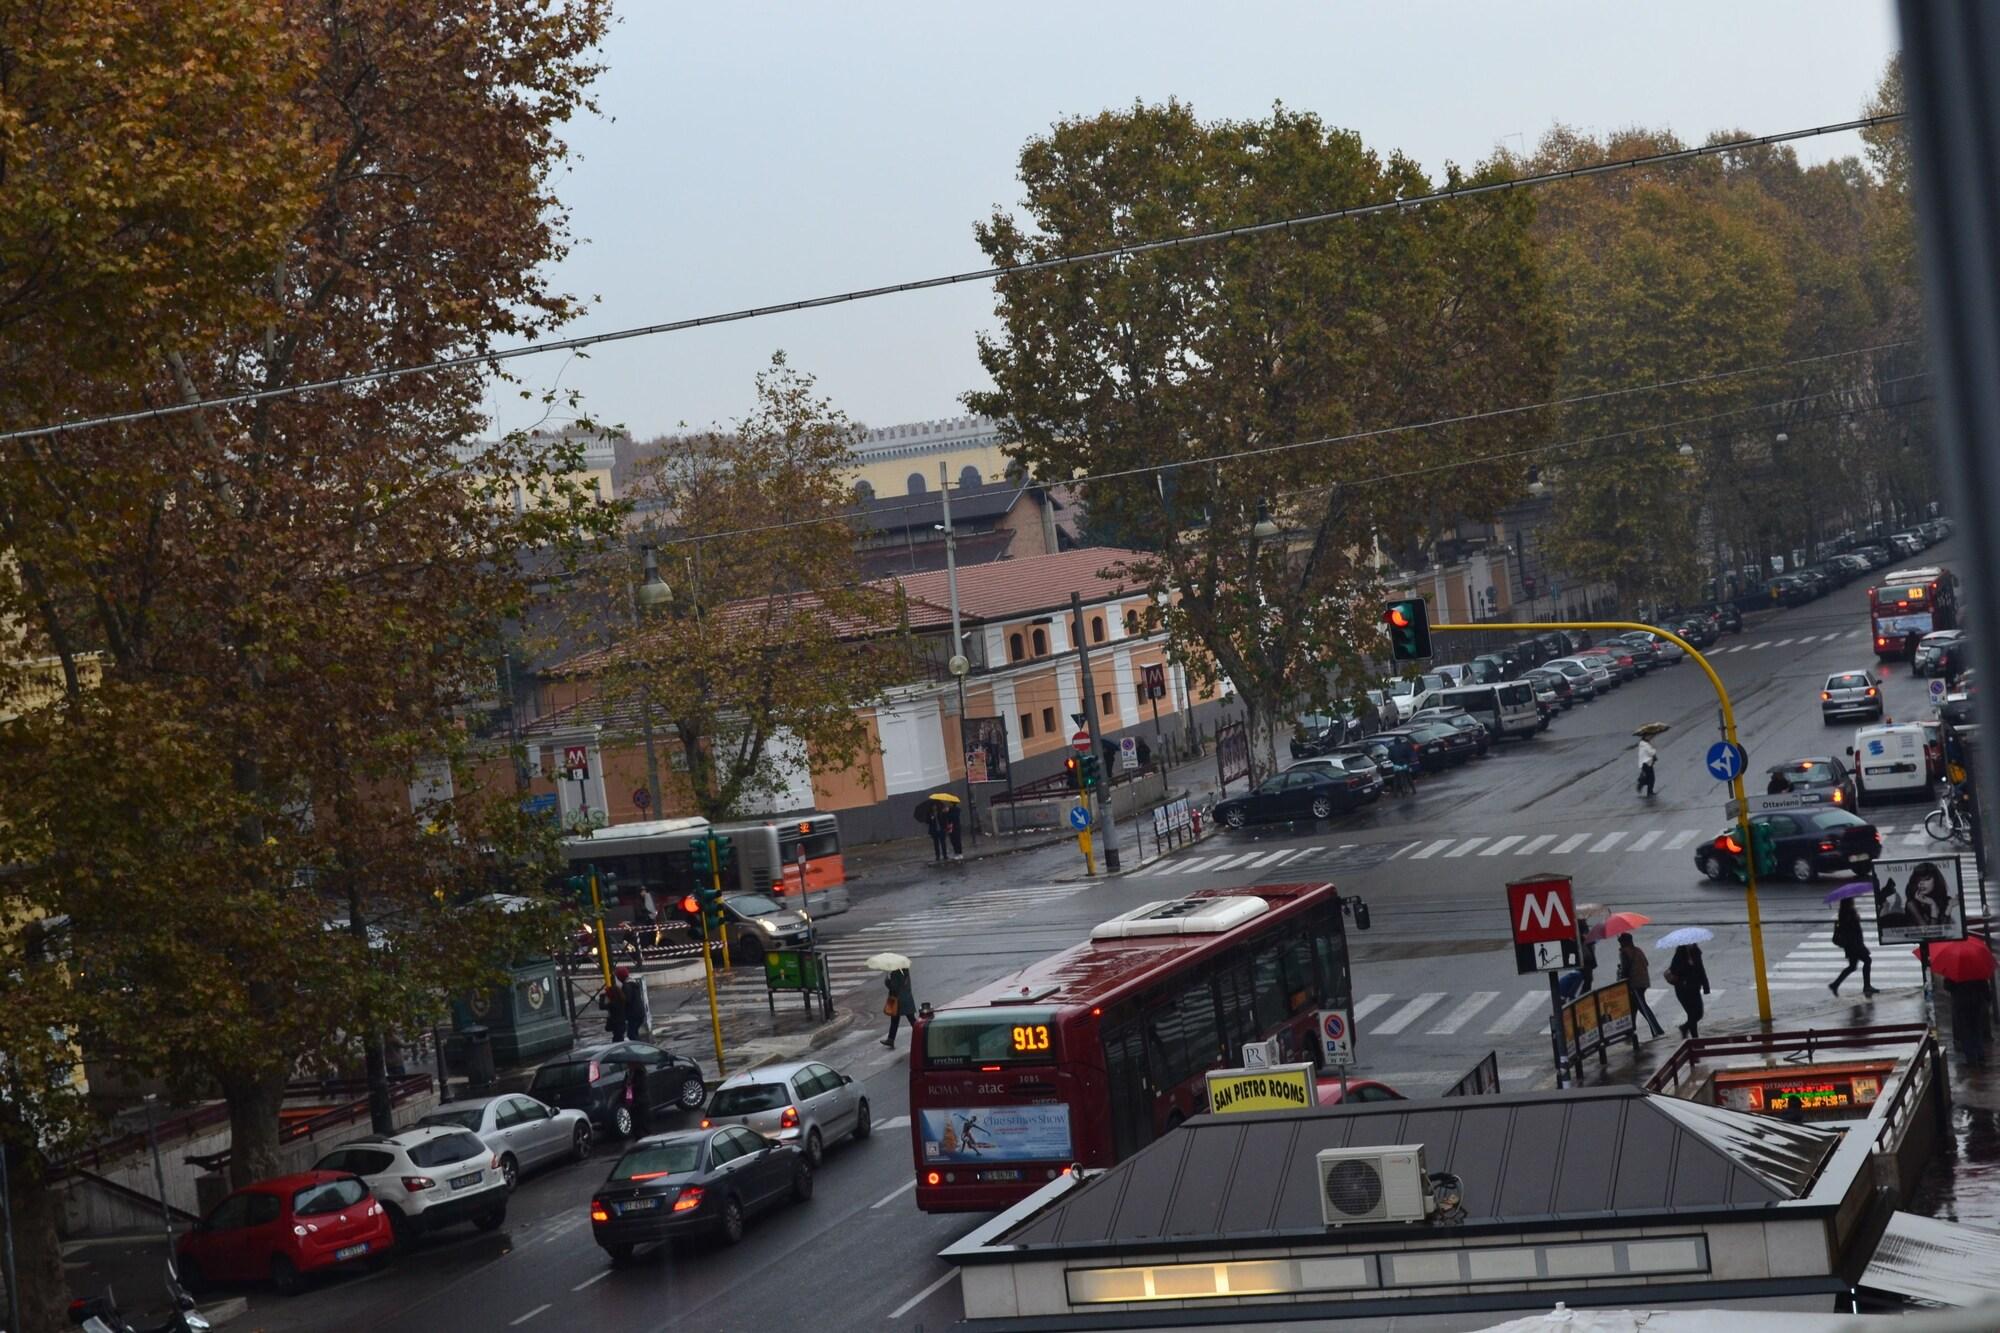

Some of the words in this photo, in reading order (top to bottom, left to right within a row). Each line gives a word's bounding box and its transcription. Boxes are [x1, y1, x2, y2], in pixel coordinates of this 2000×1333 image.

[1908, 588, 1923, 599] 913
[1149, 669, 1163, 684] M
[567, 750, 586, 765] M
[1762, 799, 1799, 809] Ottaviano
[1519, 891, 1571, 932] M
[1013, 1025, 1049, 1050] 913
[978, 1082, 1005, 1095] atac
[1214, 1086, 1233, 1111] SAN
[1233, 1079, 1267, 1102] PIETRO
[1269, 1079, 1305, 1104] ROOMS
